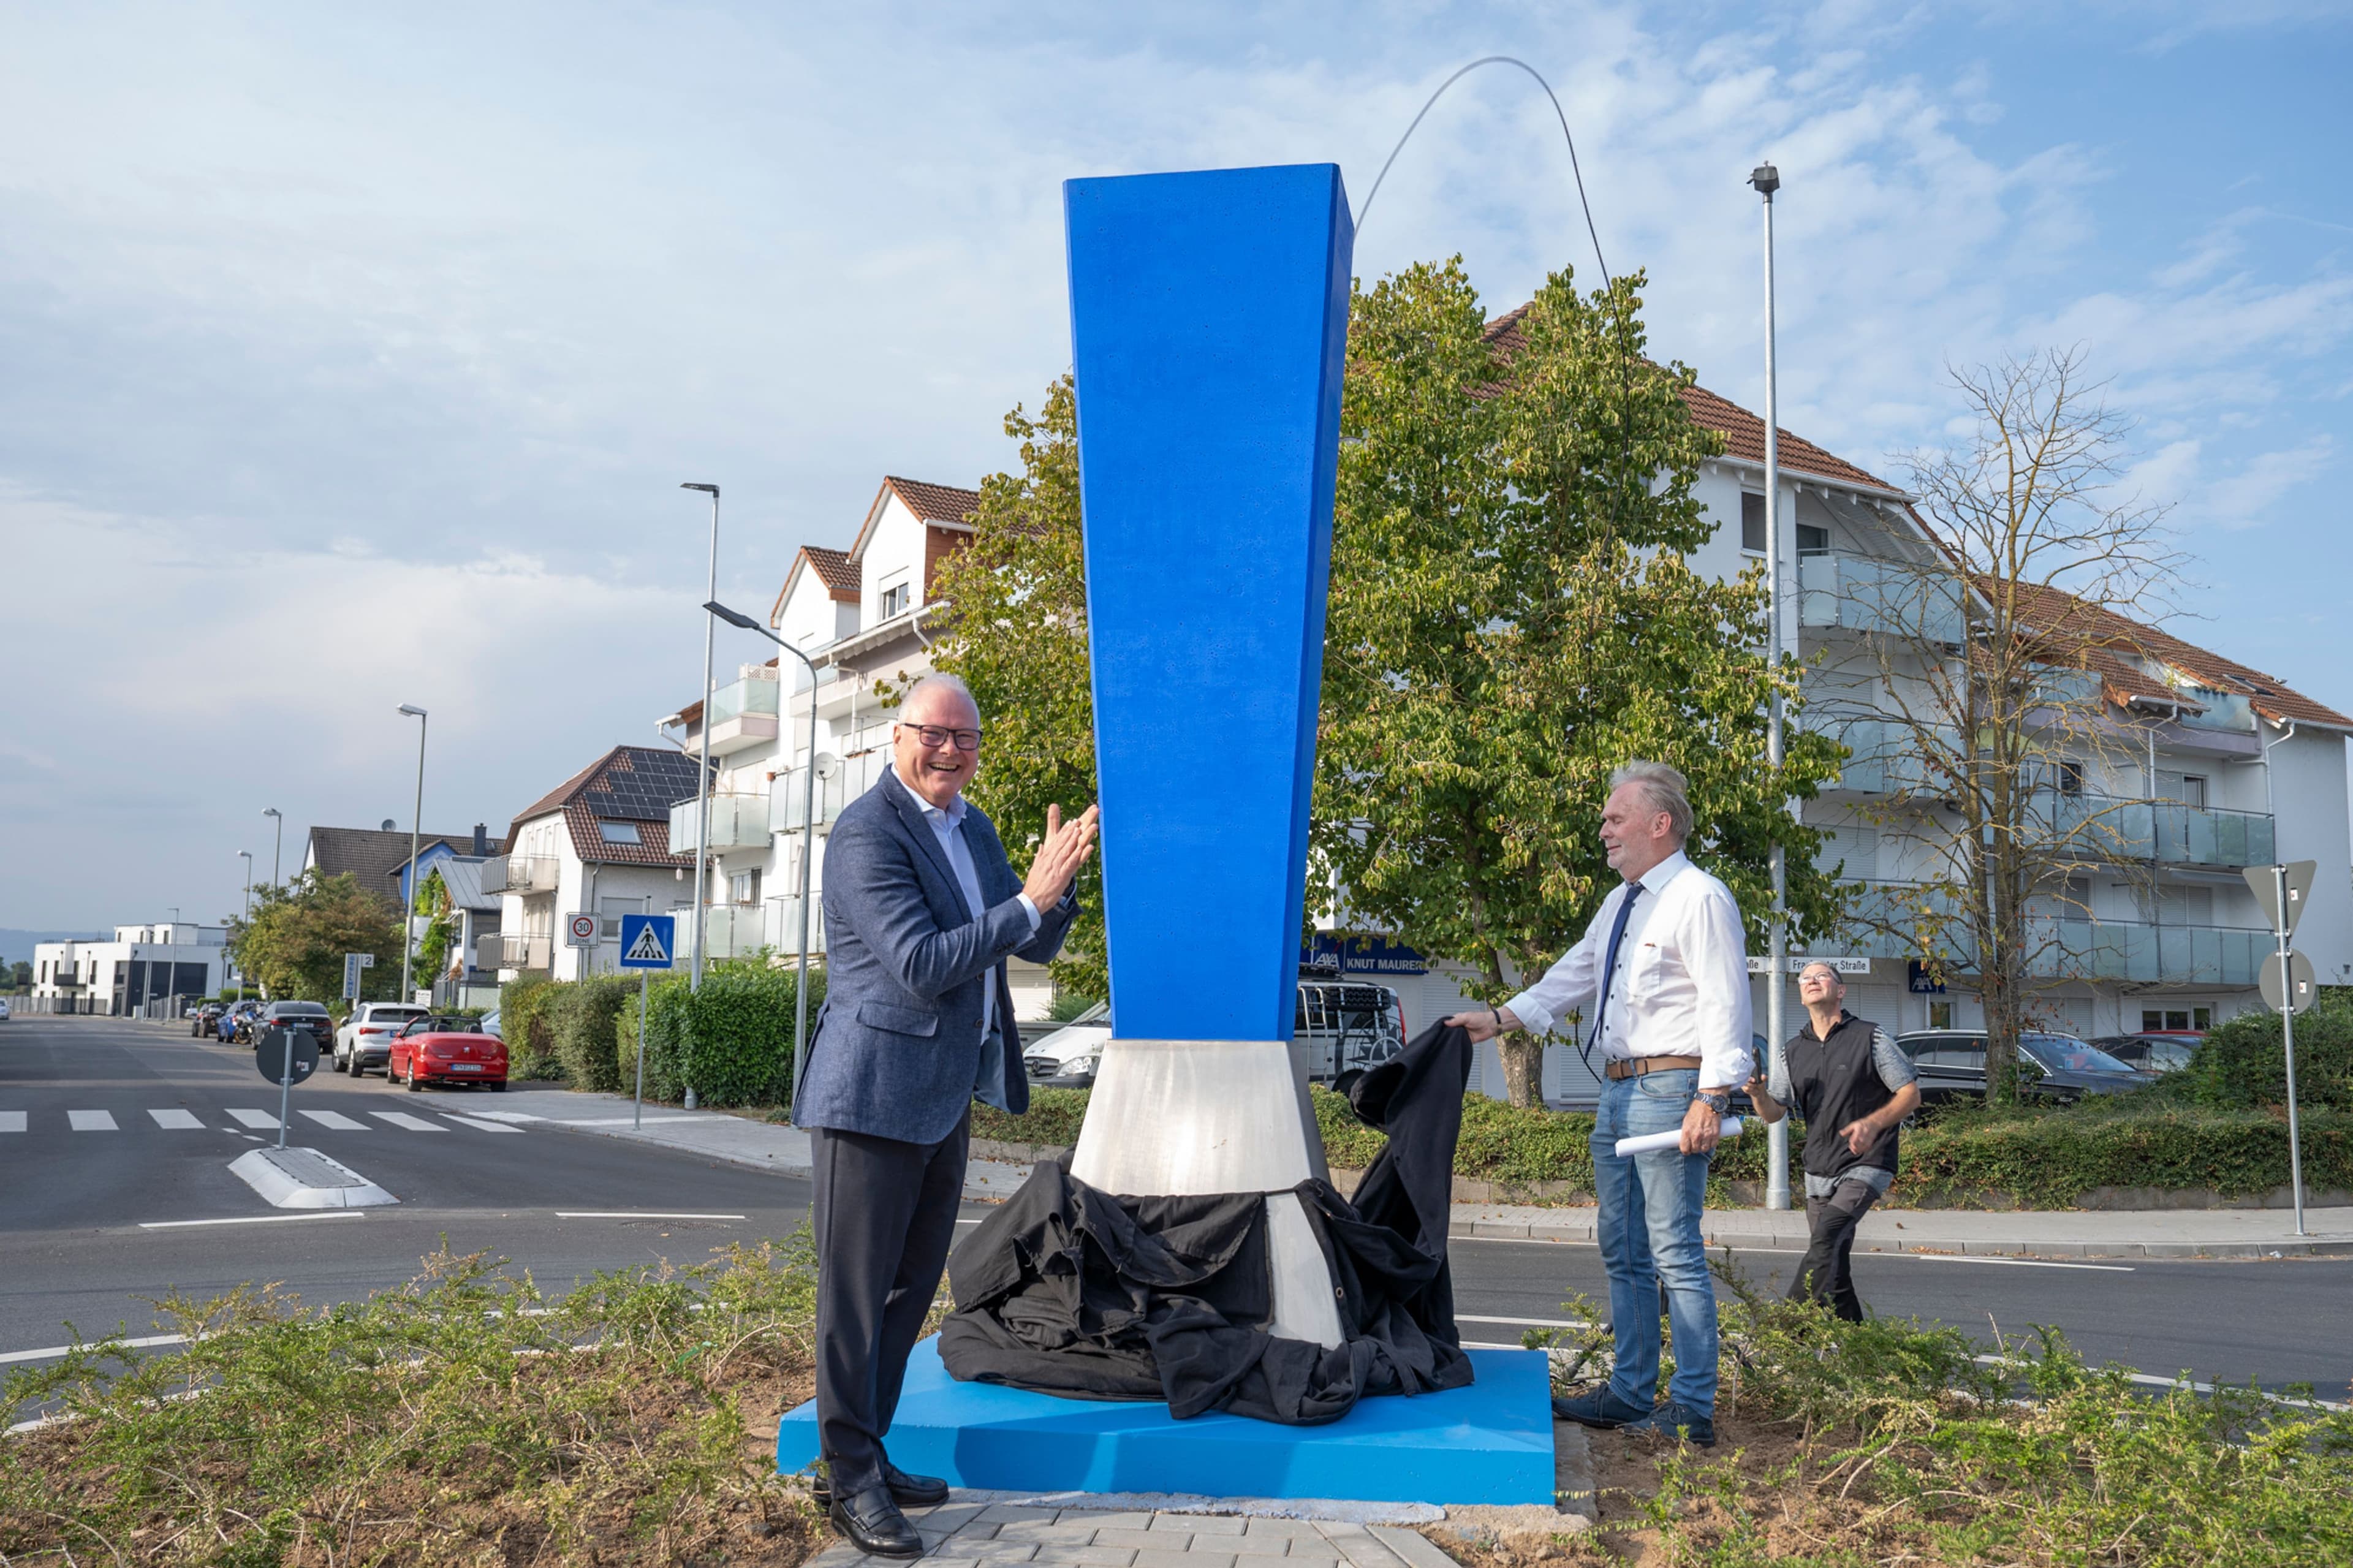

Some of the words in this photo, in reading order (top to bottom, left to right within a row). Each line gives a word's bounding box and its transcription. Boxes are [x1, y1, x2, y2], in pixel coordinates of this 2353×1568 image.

[577, 922, 589, 932] 30
[365, 956, 371, 965] 2
[1314, 953, 1339, 968] AXA
[1347, 958, 1376, 969] KNUT
[1378, 959, 1423, 971] MAURER
[1840, 960, 1866, 970] Straße
[1912, 977, 1932, 990] AXA
